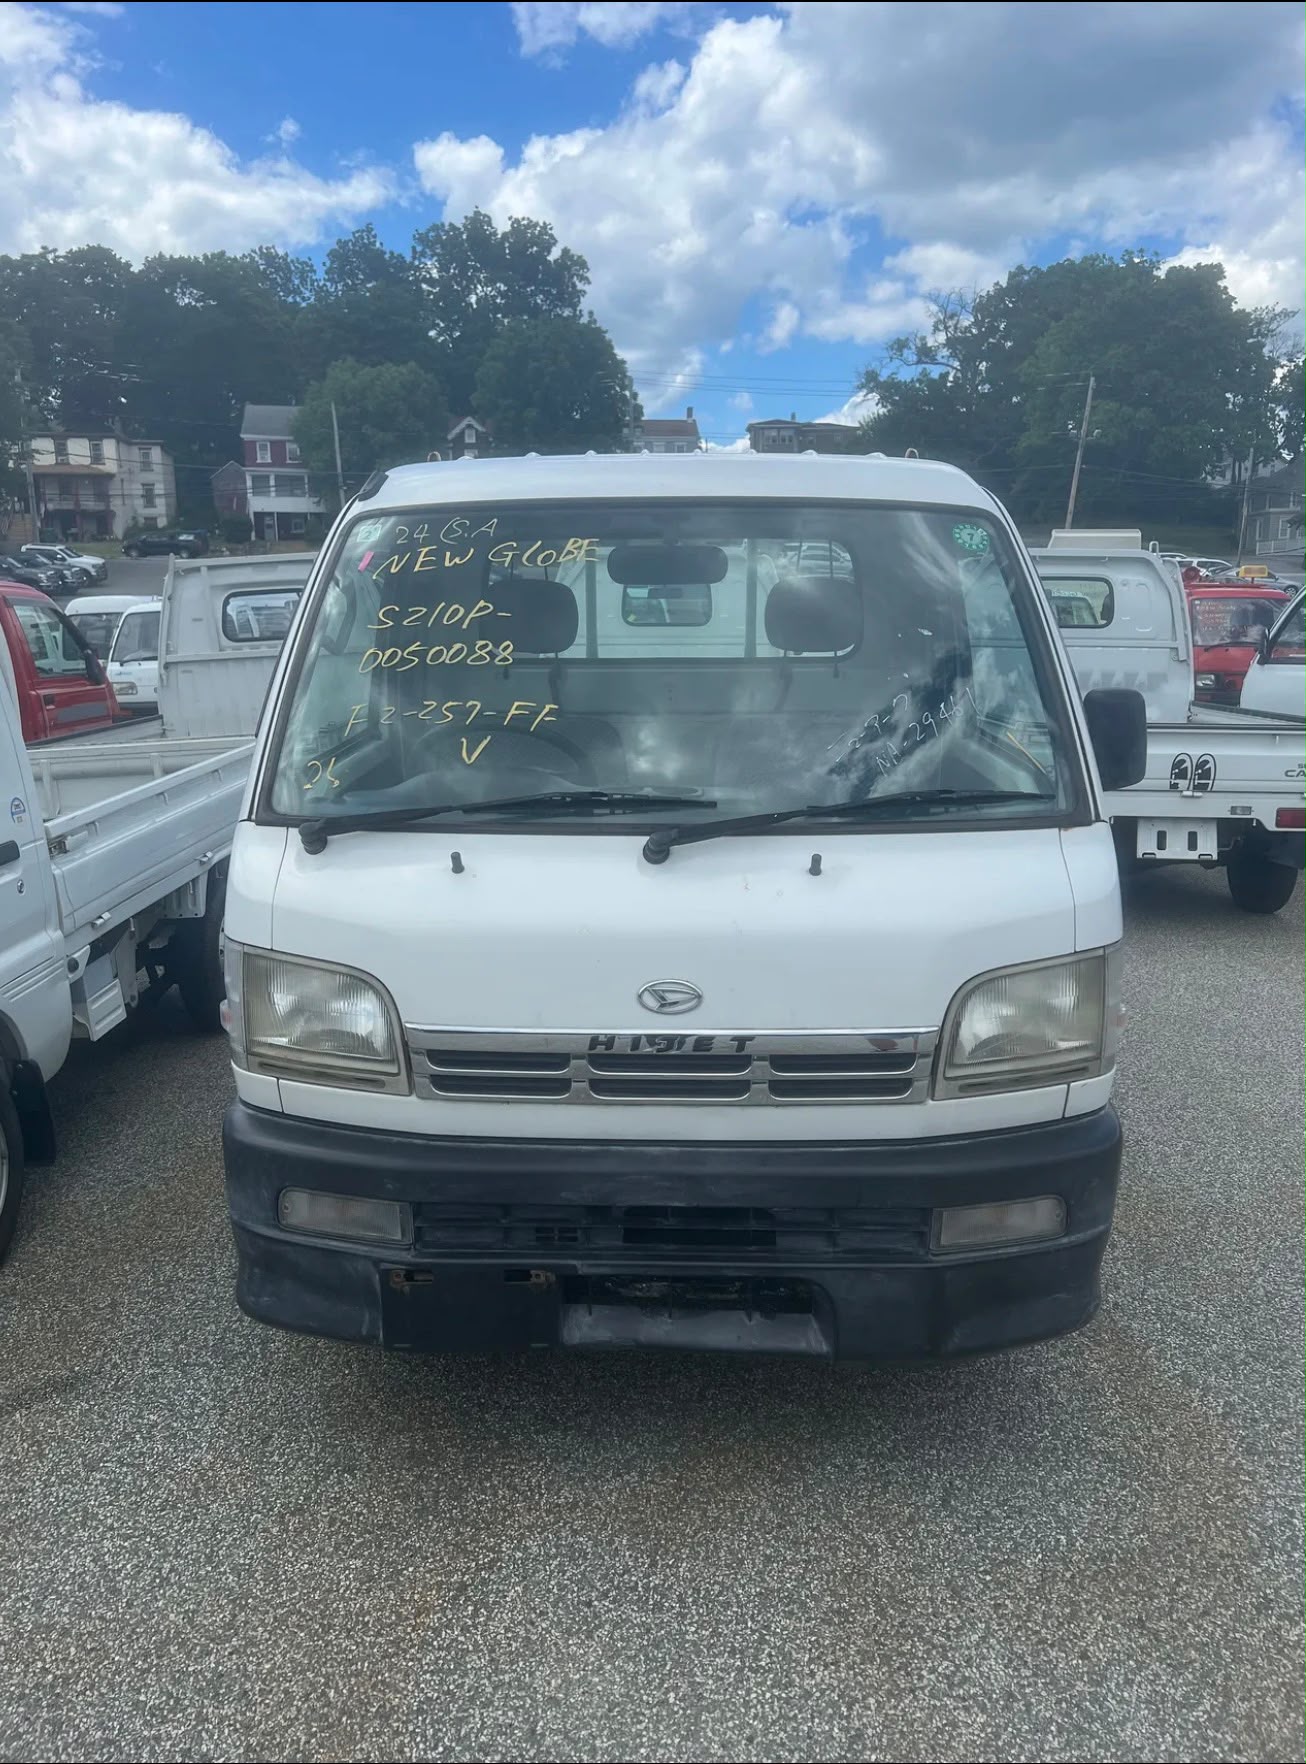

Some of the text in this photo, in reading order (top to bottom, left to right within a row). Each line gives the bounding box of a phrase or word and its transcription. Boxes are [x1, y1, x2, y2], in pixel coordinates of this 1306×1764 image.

[395, 524, 430, 545] 24
[372, 537, 601, 580] NEW GLOBE
[367, 599, 513, 630] S210P-
[358, 639, 514, 674] 0050088
[587, 1034, 757, 1054] HIJET
